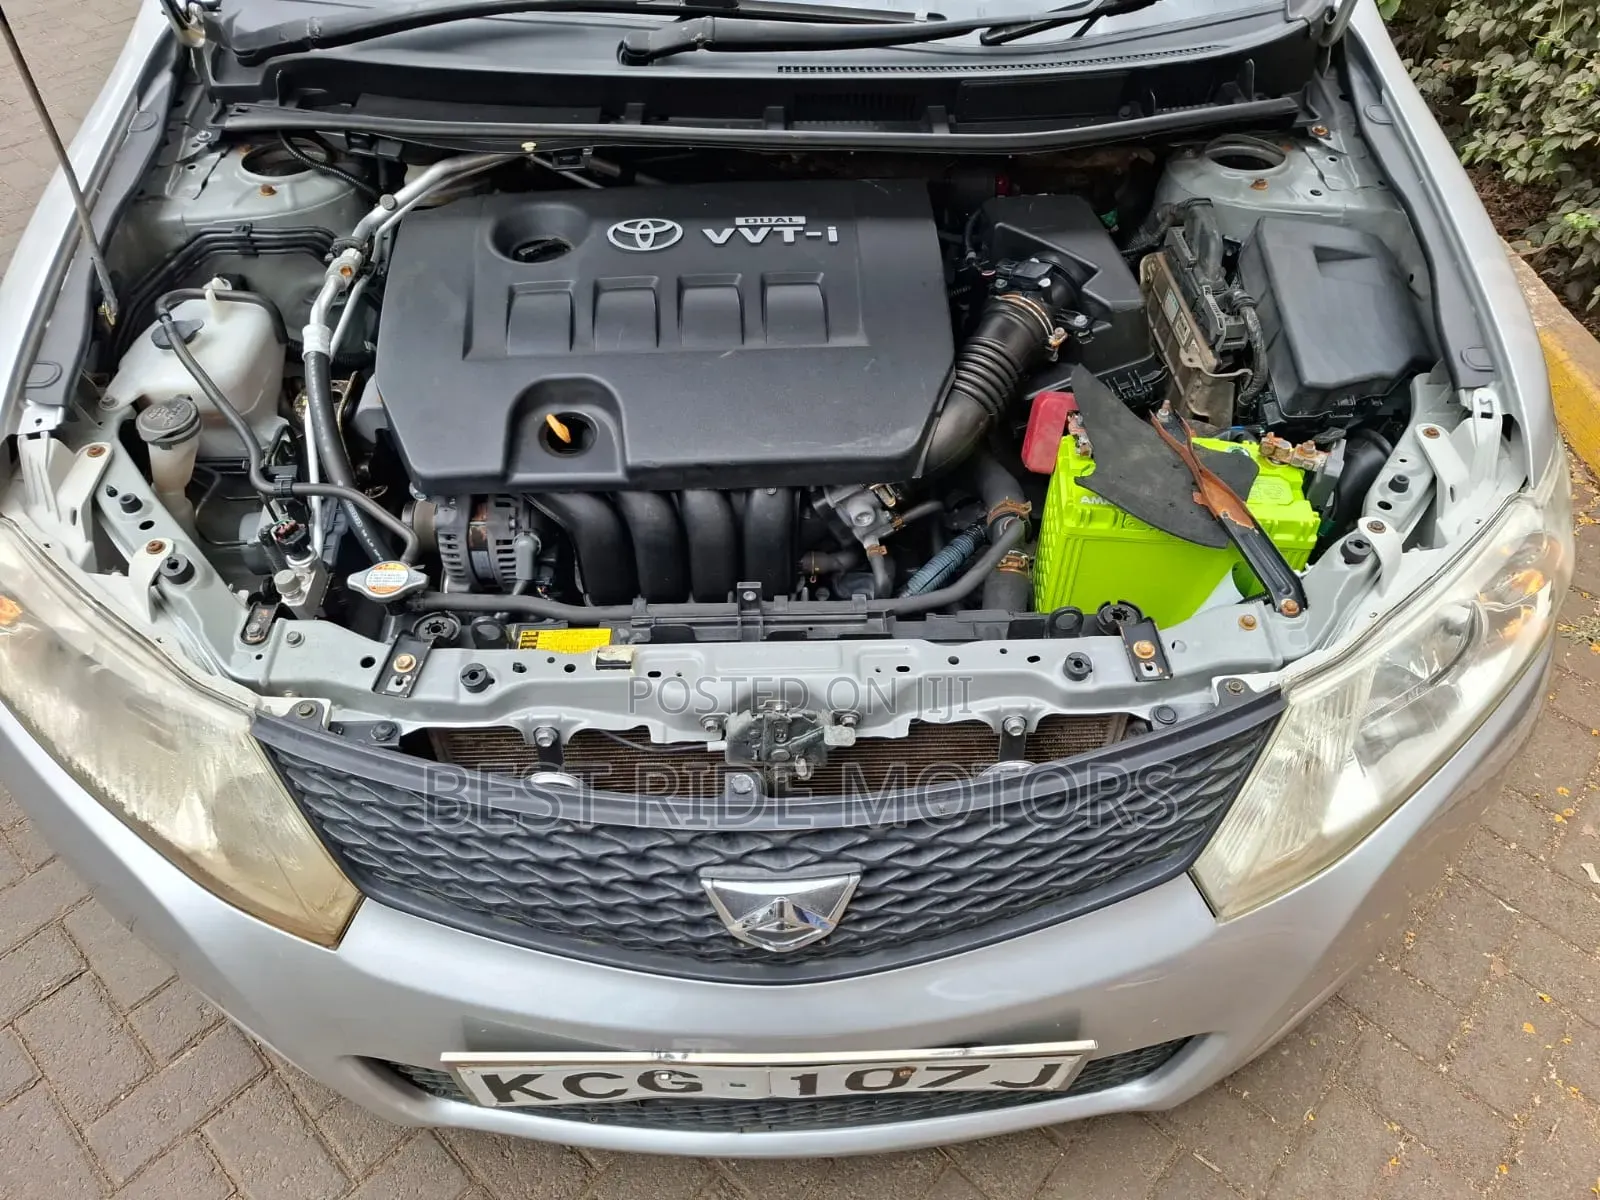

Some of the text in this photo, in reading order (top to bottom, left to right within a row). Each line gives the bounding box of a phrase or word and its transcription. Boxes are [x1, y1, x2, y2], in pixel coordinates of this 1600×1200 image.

[743, 216, 802, 224] DUAL
[702, 226, 838, 244] VVT-i
[481, 1069, 703, 1103] KCG
